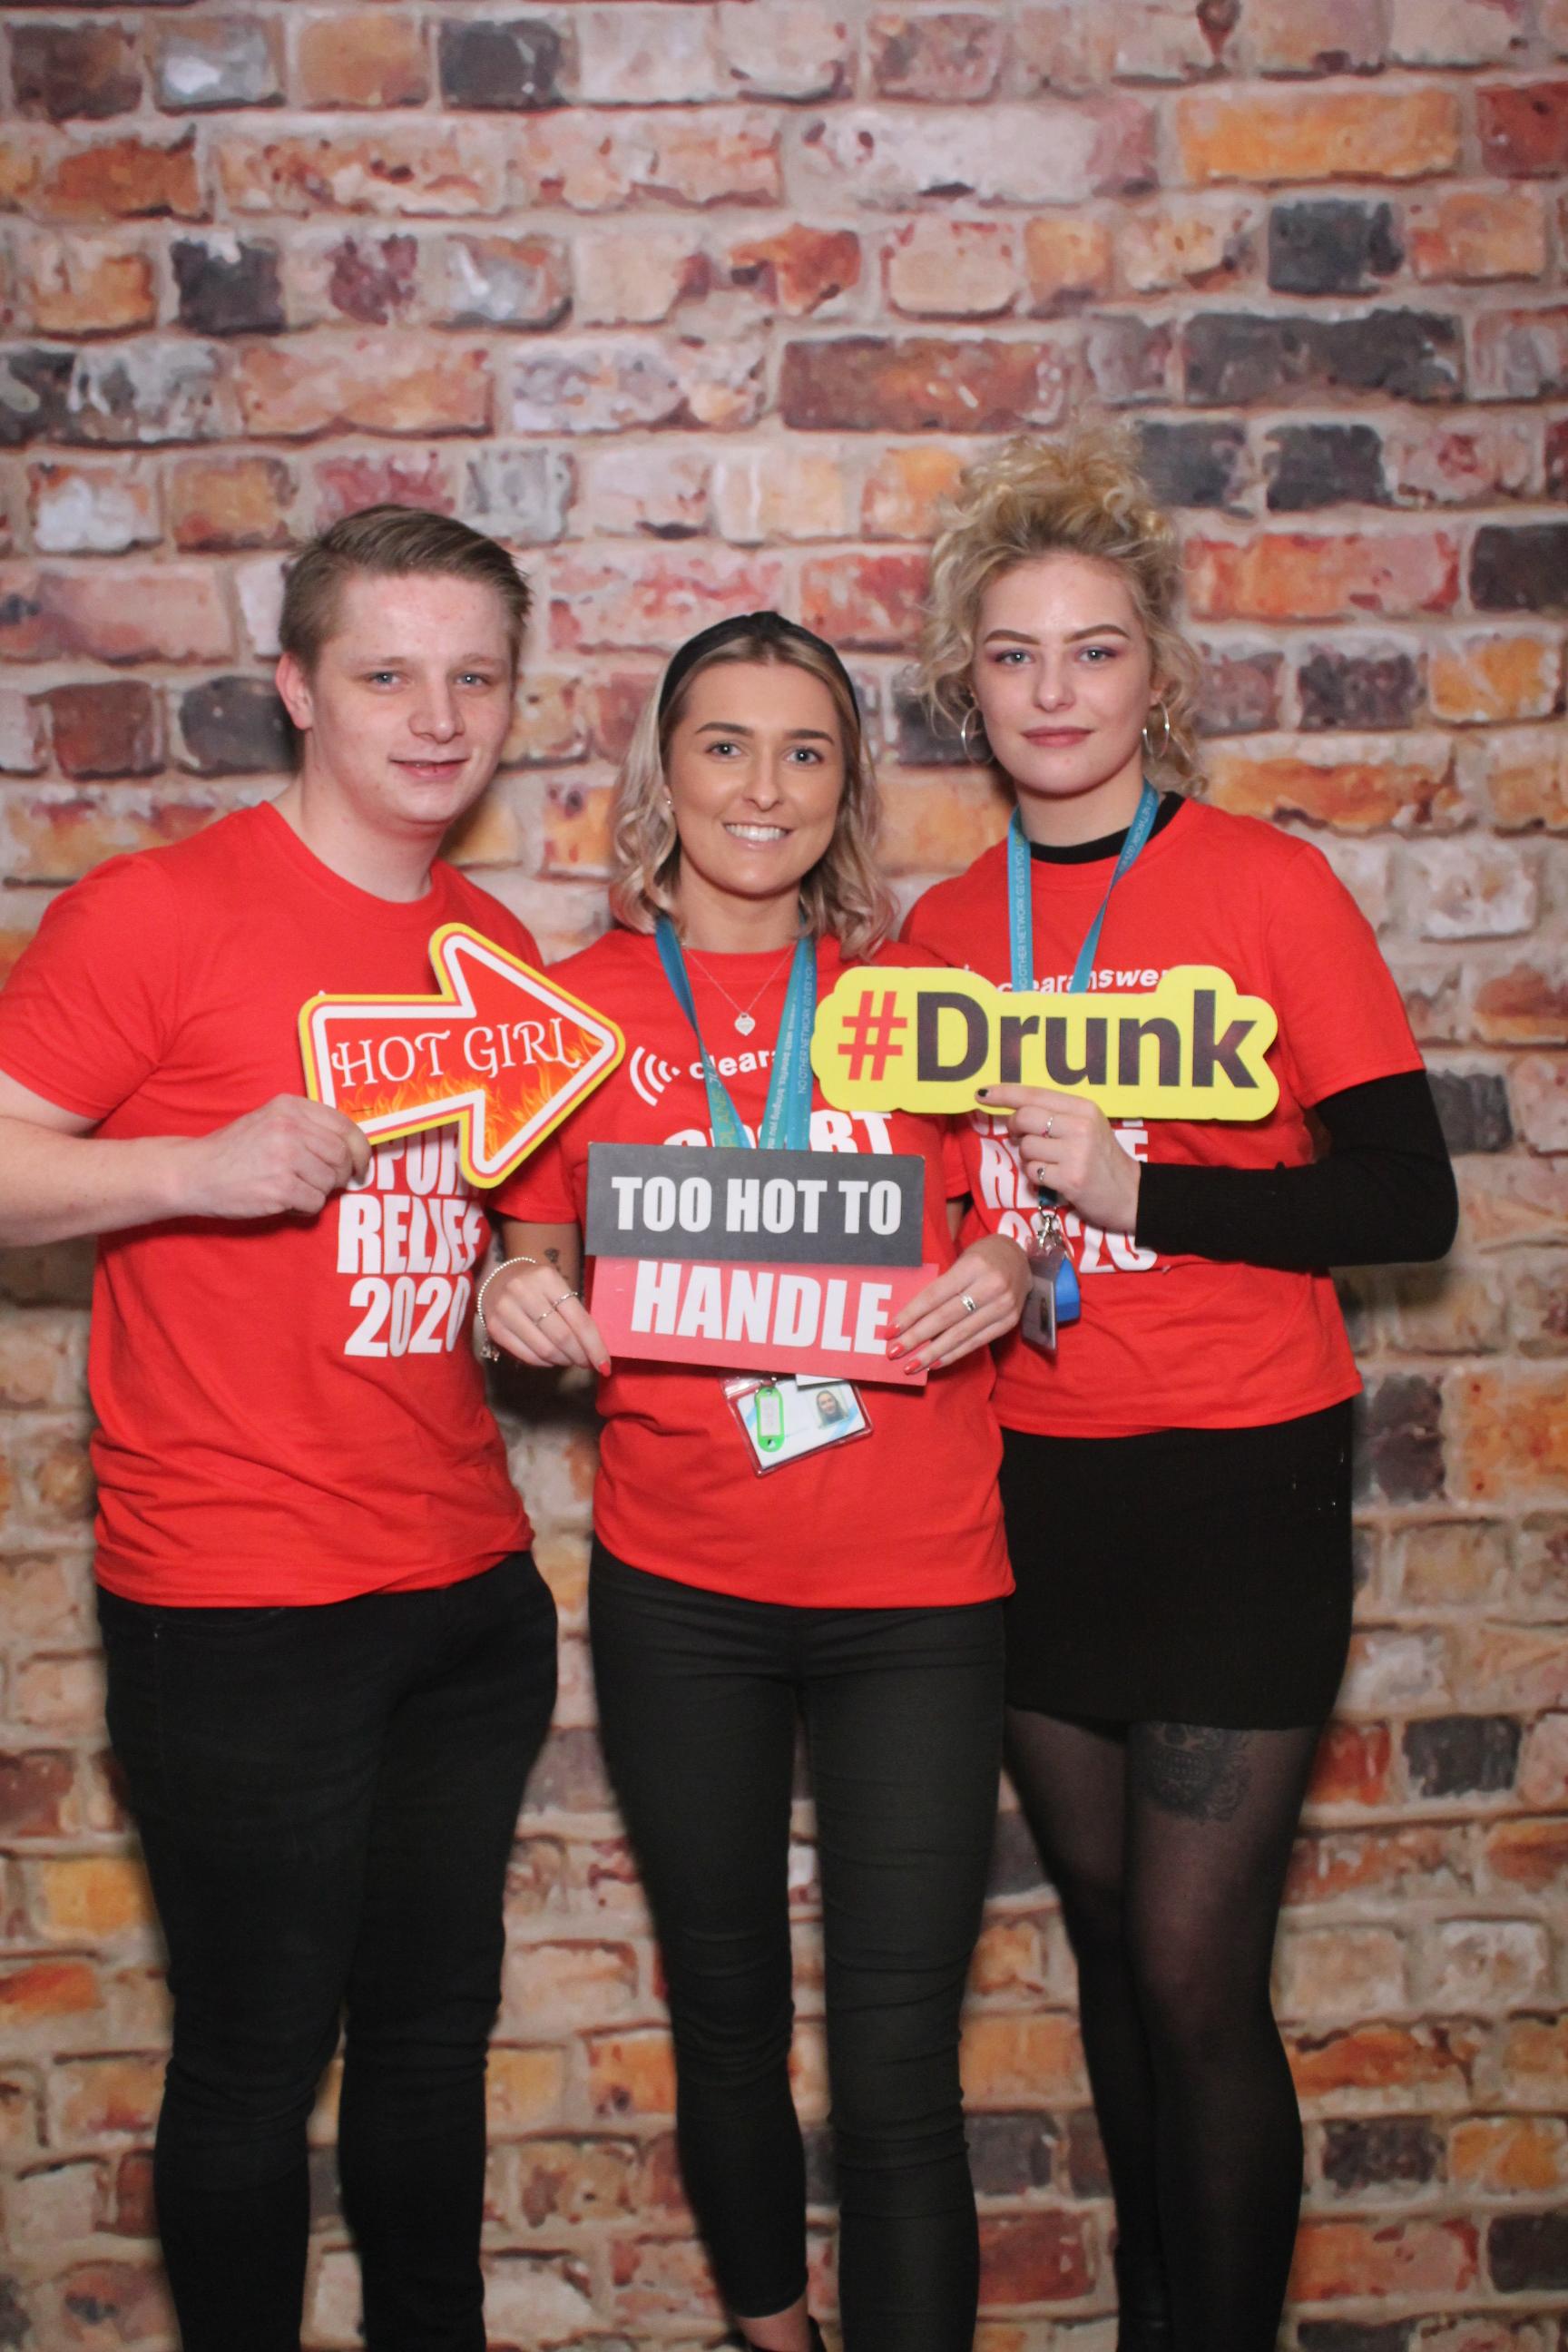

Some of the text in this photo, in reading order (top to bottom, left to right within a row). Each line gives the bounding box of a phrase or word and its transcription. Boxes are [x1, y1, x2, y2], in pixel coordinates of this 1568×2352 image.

[1015, 846, 1025, 867] YOU
[1016, 897, 1026, 943] NETWORK
[332, 1017, 582, 1087] HOT GIRL
[800, 1008, 812, 1048] NETWORK
[838, 990, 1259, 1088] #Drunk
[337, 1194, 483, 1274] RELIEF
[612, 1176, 902, 1235] TOO HOT TO
[344, 1275, 471, 1357] 2020
[631, 1259, 892, 1356] HANDLE
